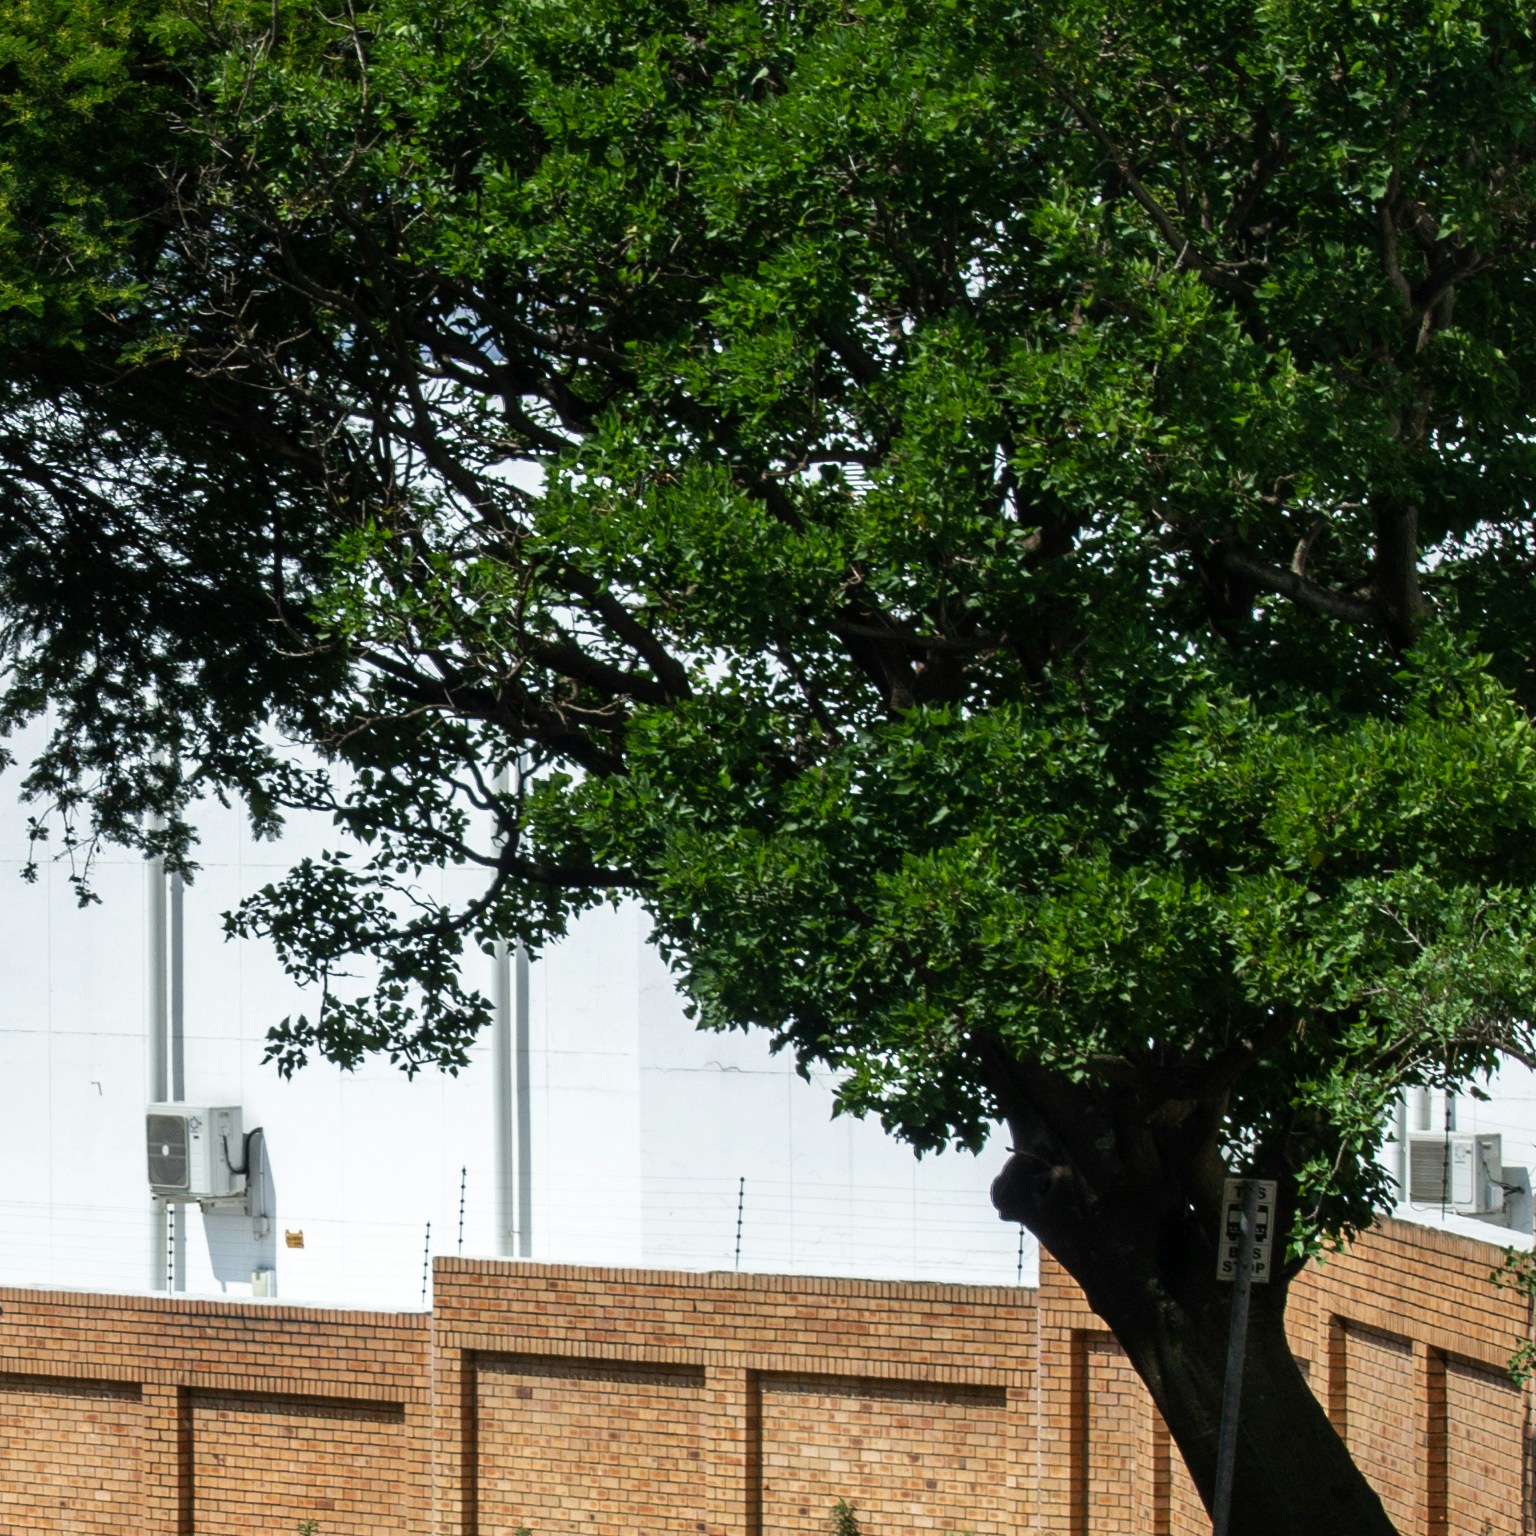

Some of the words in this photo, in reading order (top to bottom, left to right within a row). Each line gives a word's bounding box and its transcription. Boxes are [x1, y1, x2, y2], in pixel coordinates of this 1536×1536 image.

[1234, 1185, 1266, 1200] TS
[1228, 1246, 1261, 1259] BS
[1223, 1260, 1265, 1273] SP
